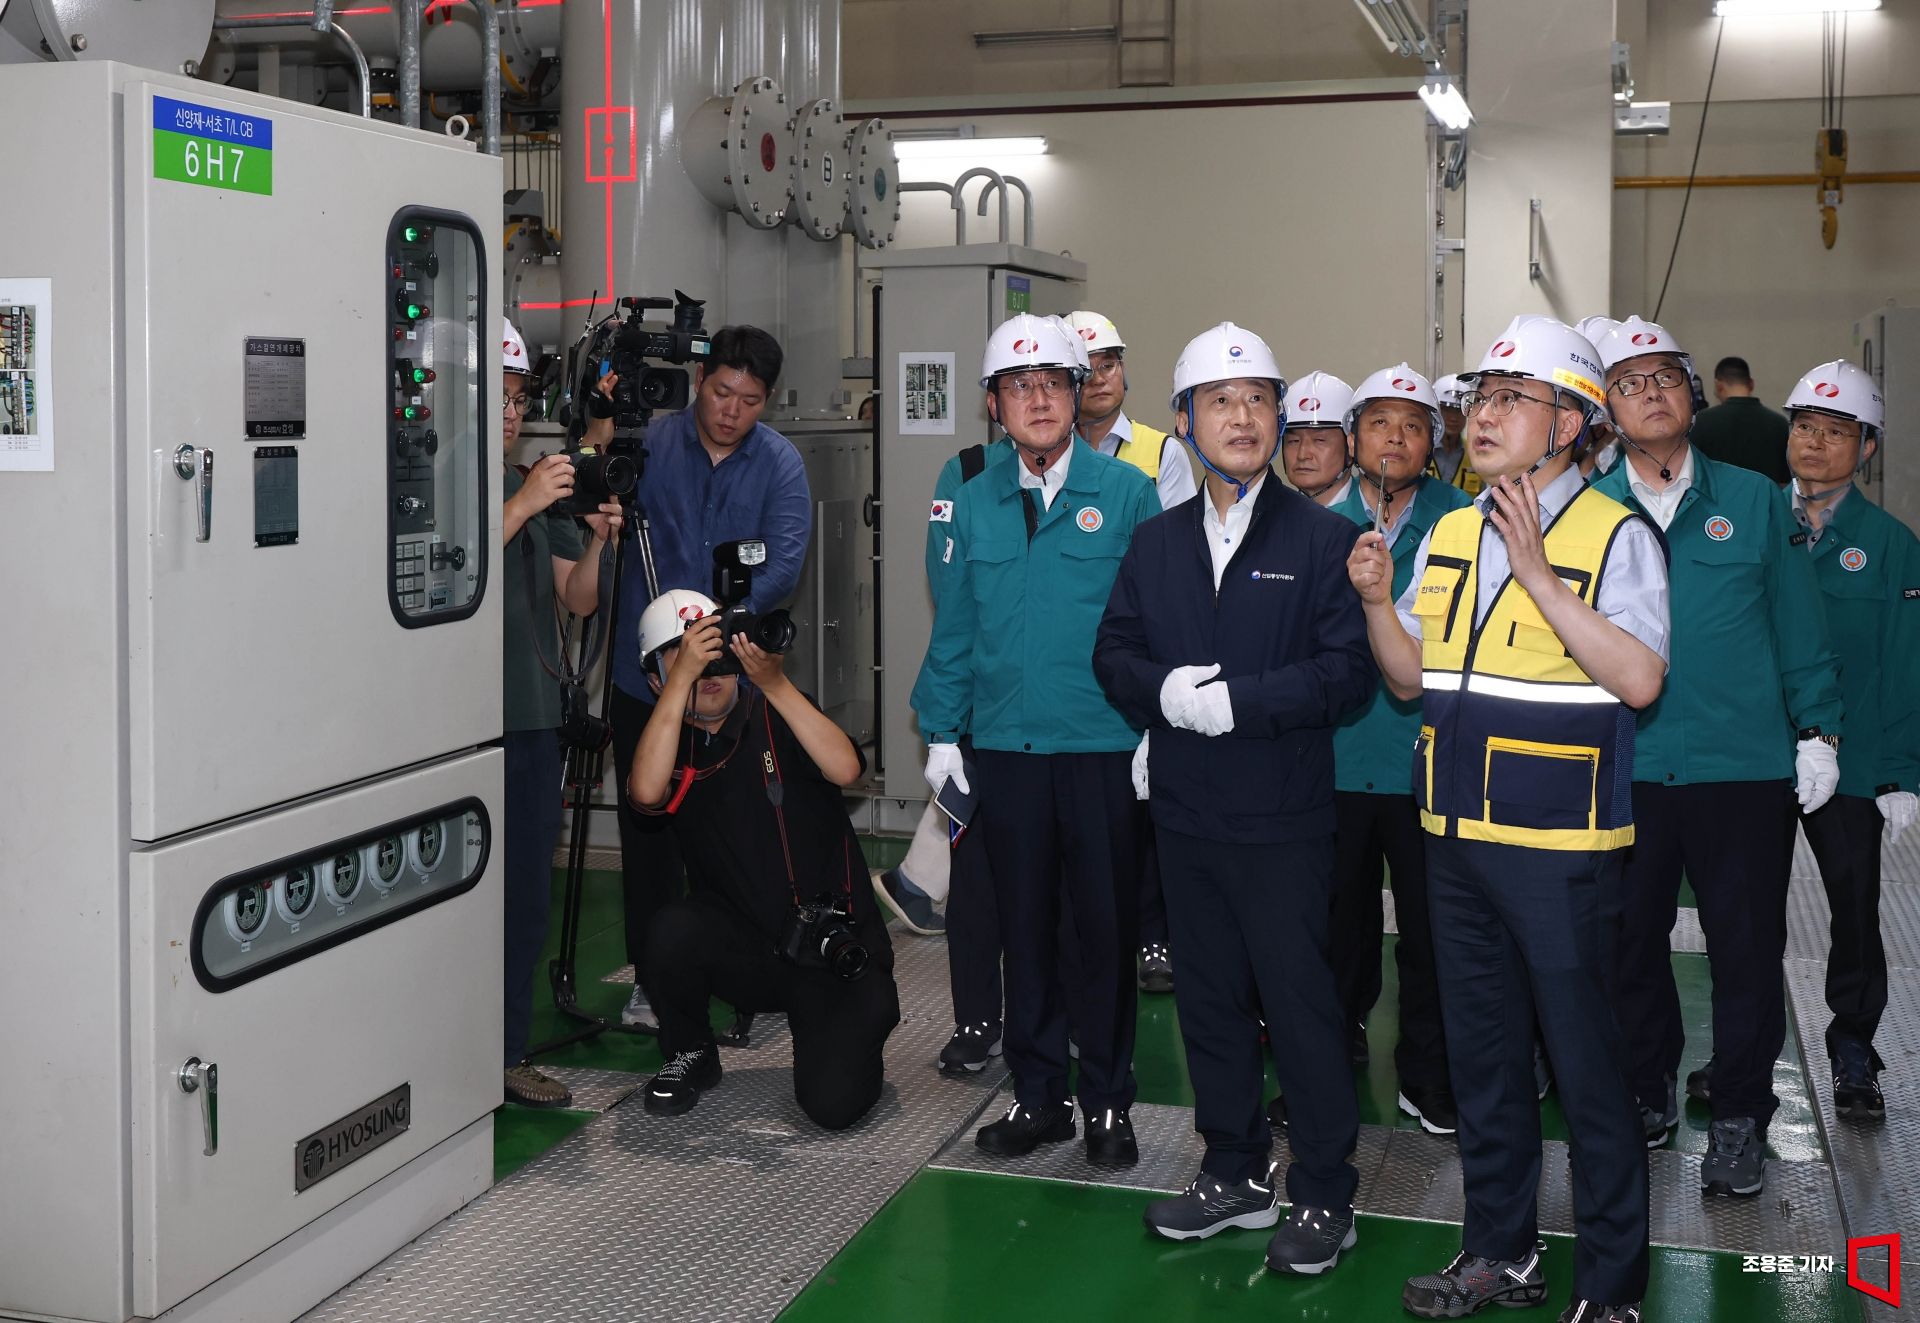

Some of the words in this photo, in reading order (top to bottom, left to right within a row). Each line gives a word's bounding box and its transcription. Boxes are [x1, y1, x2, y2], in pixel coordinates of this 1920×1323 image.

[175, 108, 223, 133] 신양재-서초
[225, 117, 239, 136] T/L
[240, 120, 253, 138] CB
[185, 140, 244, 183] 6H7
[823, 156, 832, 183] B
[1570, 352, 1603, 379] 한국전력
[1421, 585, 1448, 594] 한국전력
[763, 750, 774, 773] EOS
[328, 1098, 406, 1163] HYOSUNG
